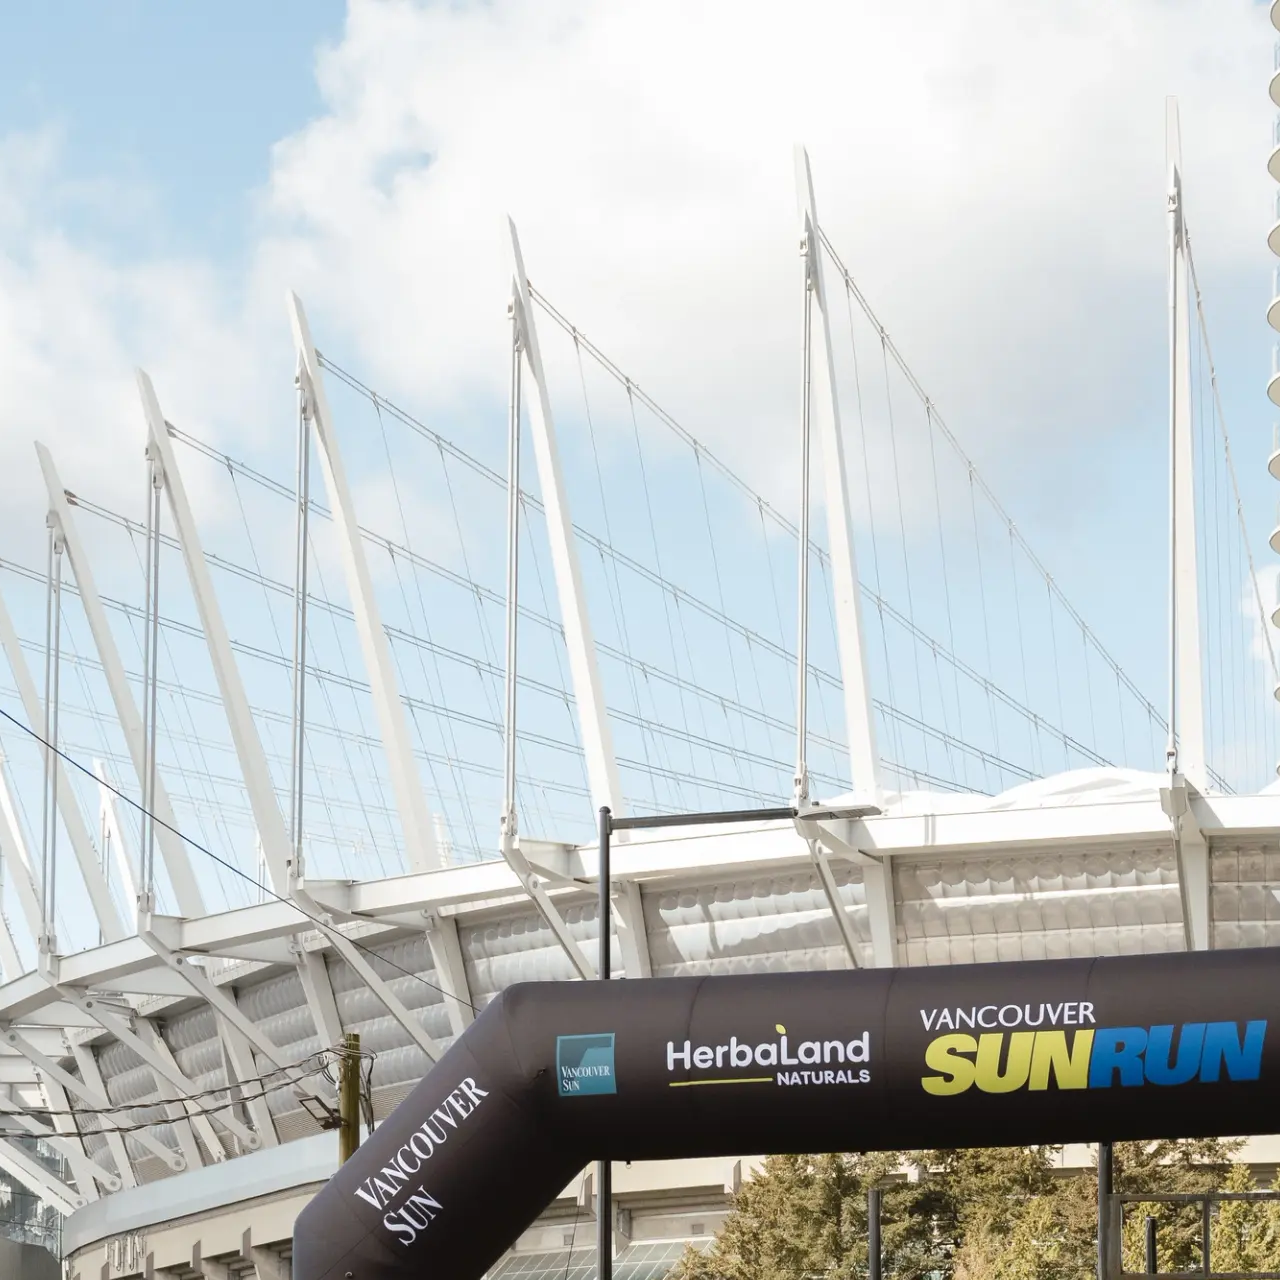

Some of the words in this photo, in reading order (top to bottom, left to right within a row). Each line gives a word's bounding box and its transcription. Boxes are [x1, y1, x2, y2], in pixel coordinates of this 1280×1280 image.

[919, 1001, 1096, 1031] VANCOUVER
[561, 1064, 611, 1079] VANCOUVER
[776, 1069, 871, 1086] NATURALS
[562, 1078, 580, 1092] SUN
[353, 1077, 489, 1211] VANCOUVER
[383, 1184, 444, 1247] SUN
